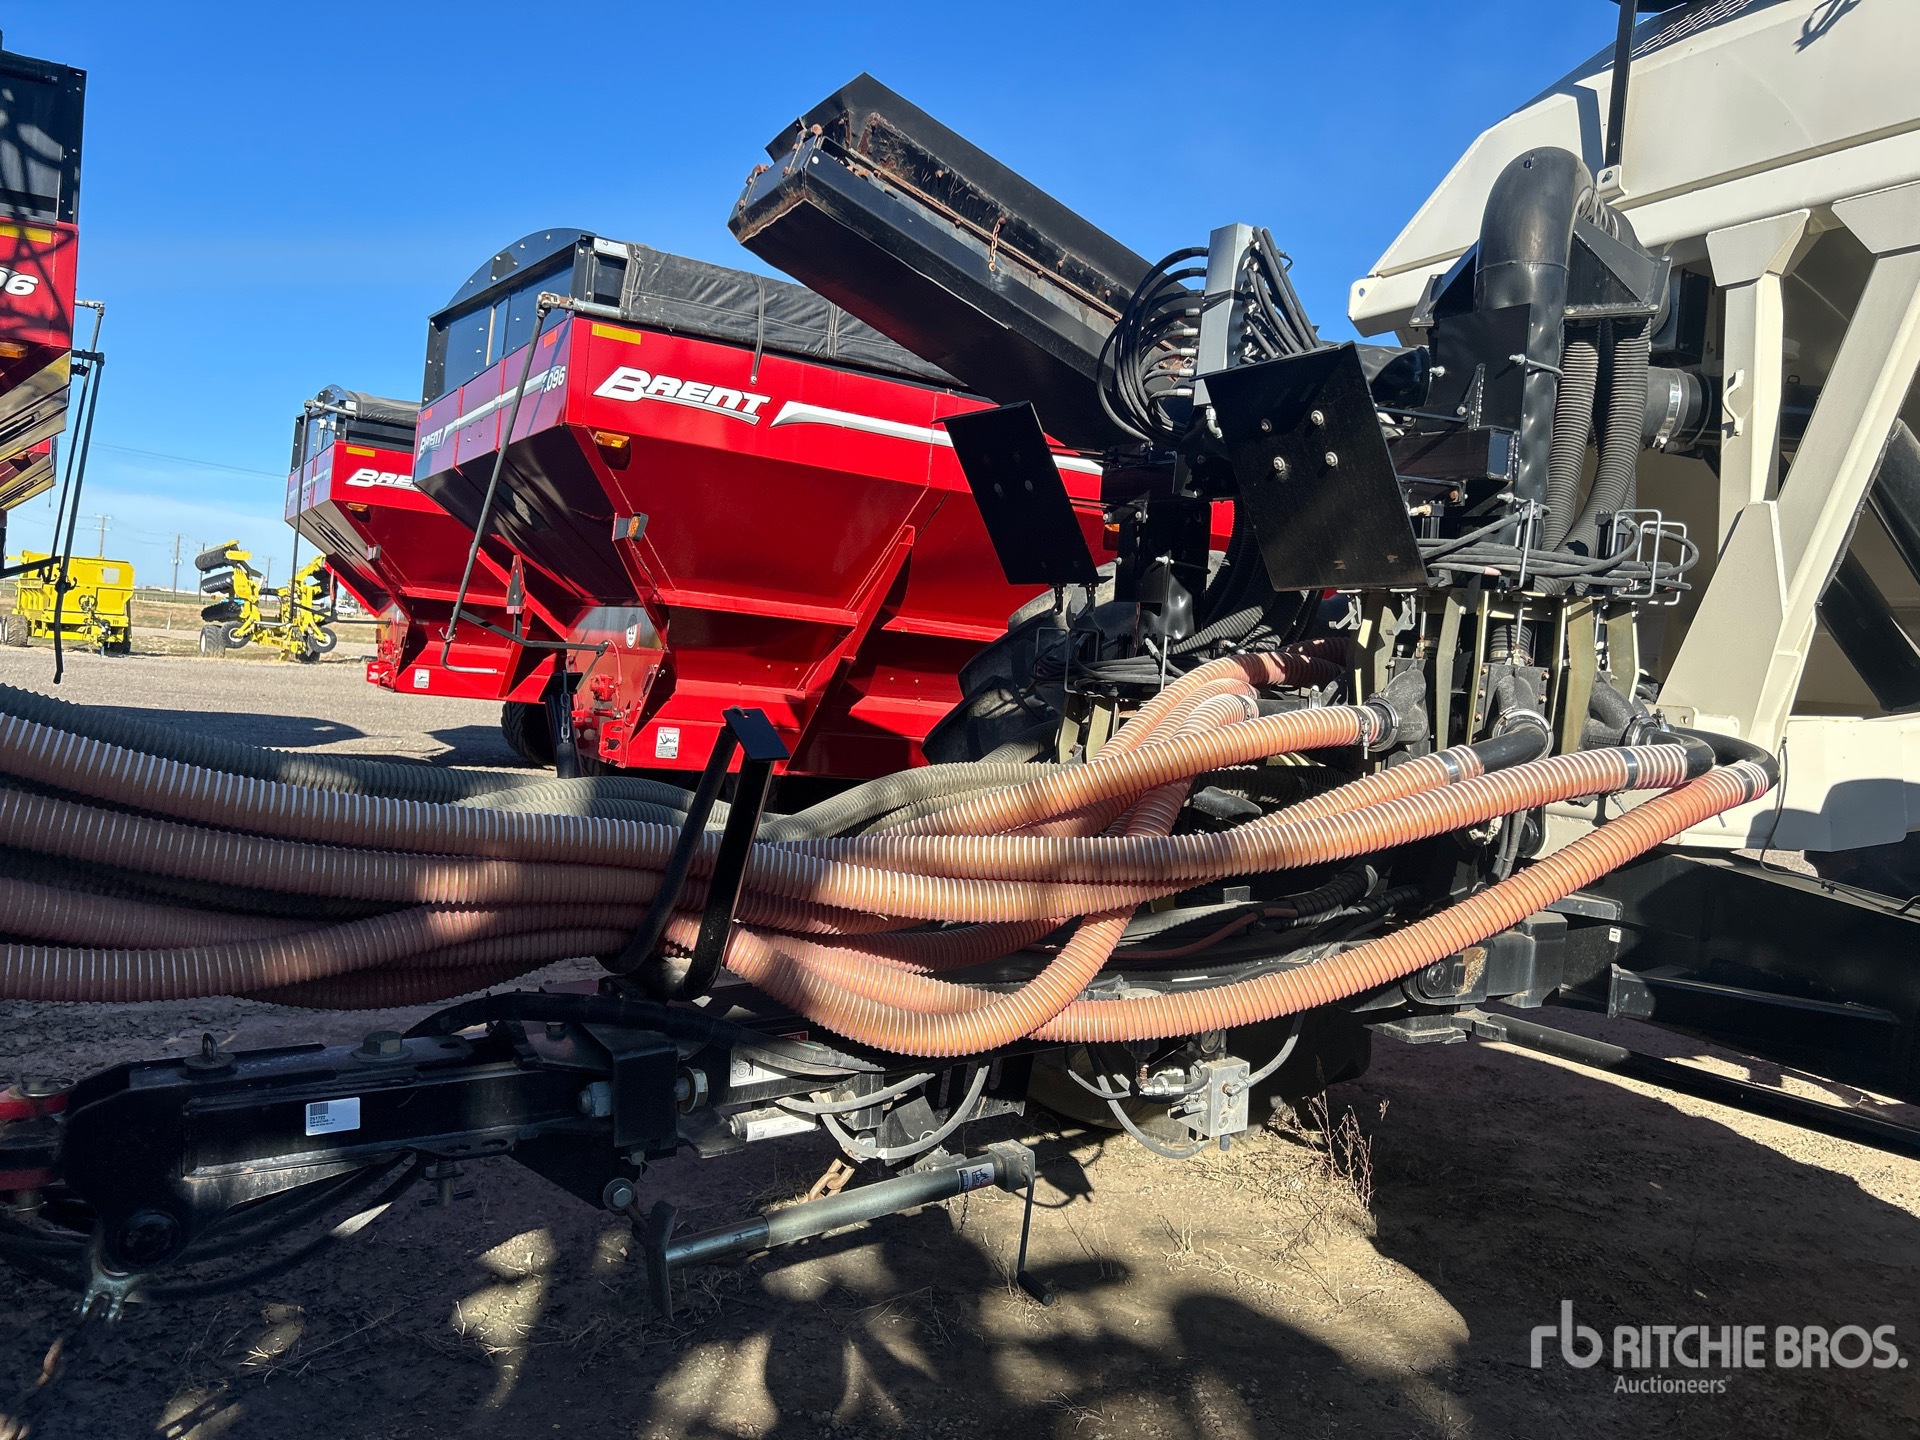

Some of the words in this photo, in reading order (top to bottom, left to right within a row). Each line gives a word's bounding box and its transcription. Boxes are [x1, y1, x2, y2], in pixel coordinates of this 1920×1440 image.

[593, 366, 772, 424] BRENT
[417, 428, 444, 461] BRENT
[345, 467, 415, 488] BRE
